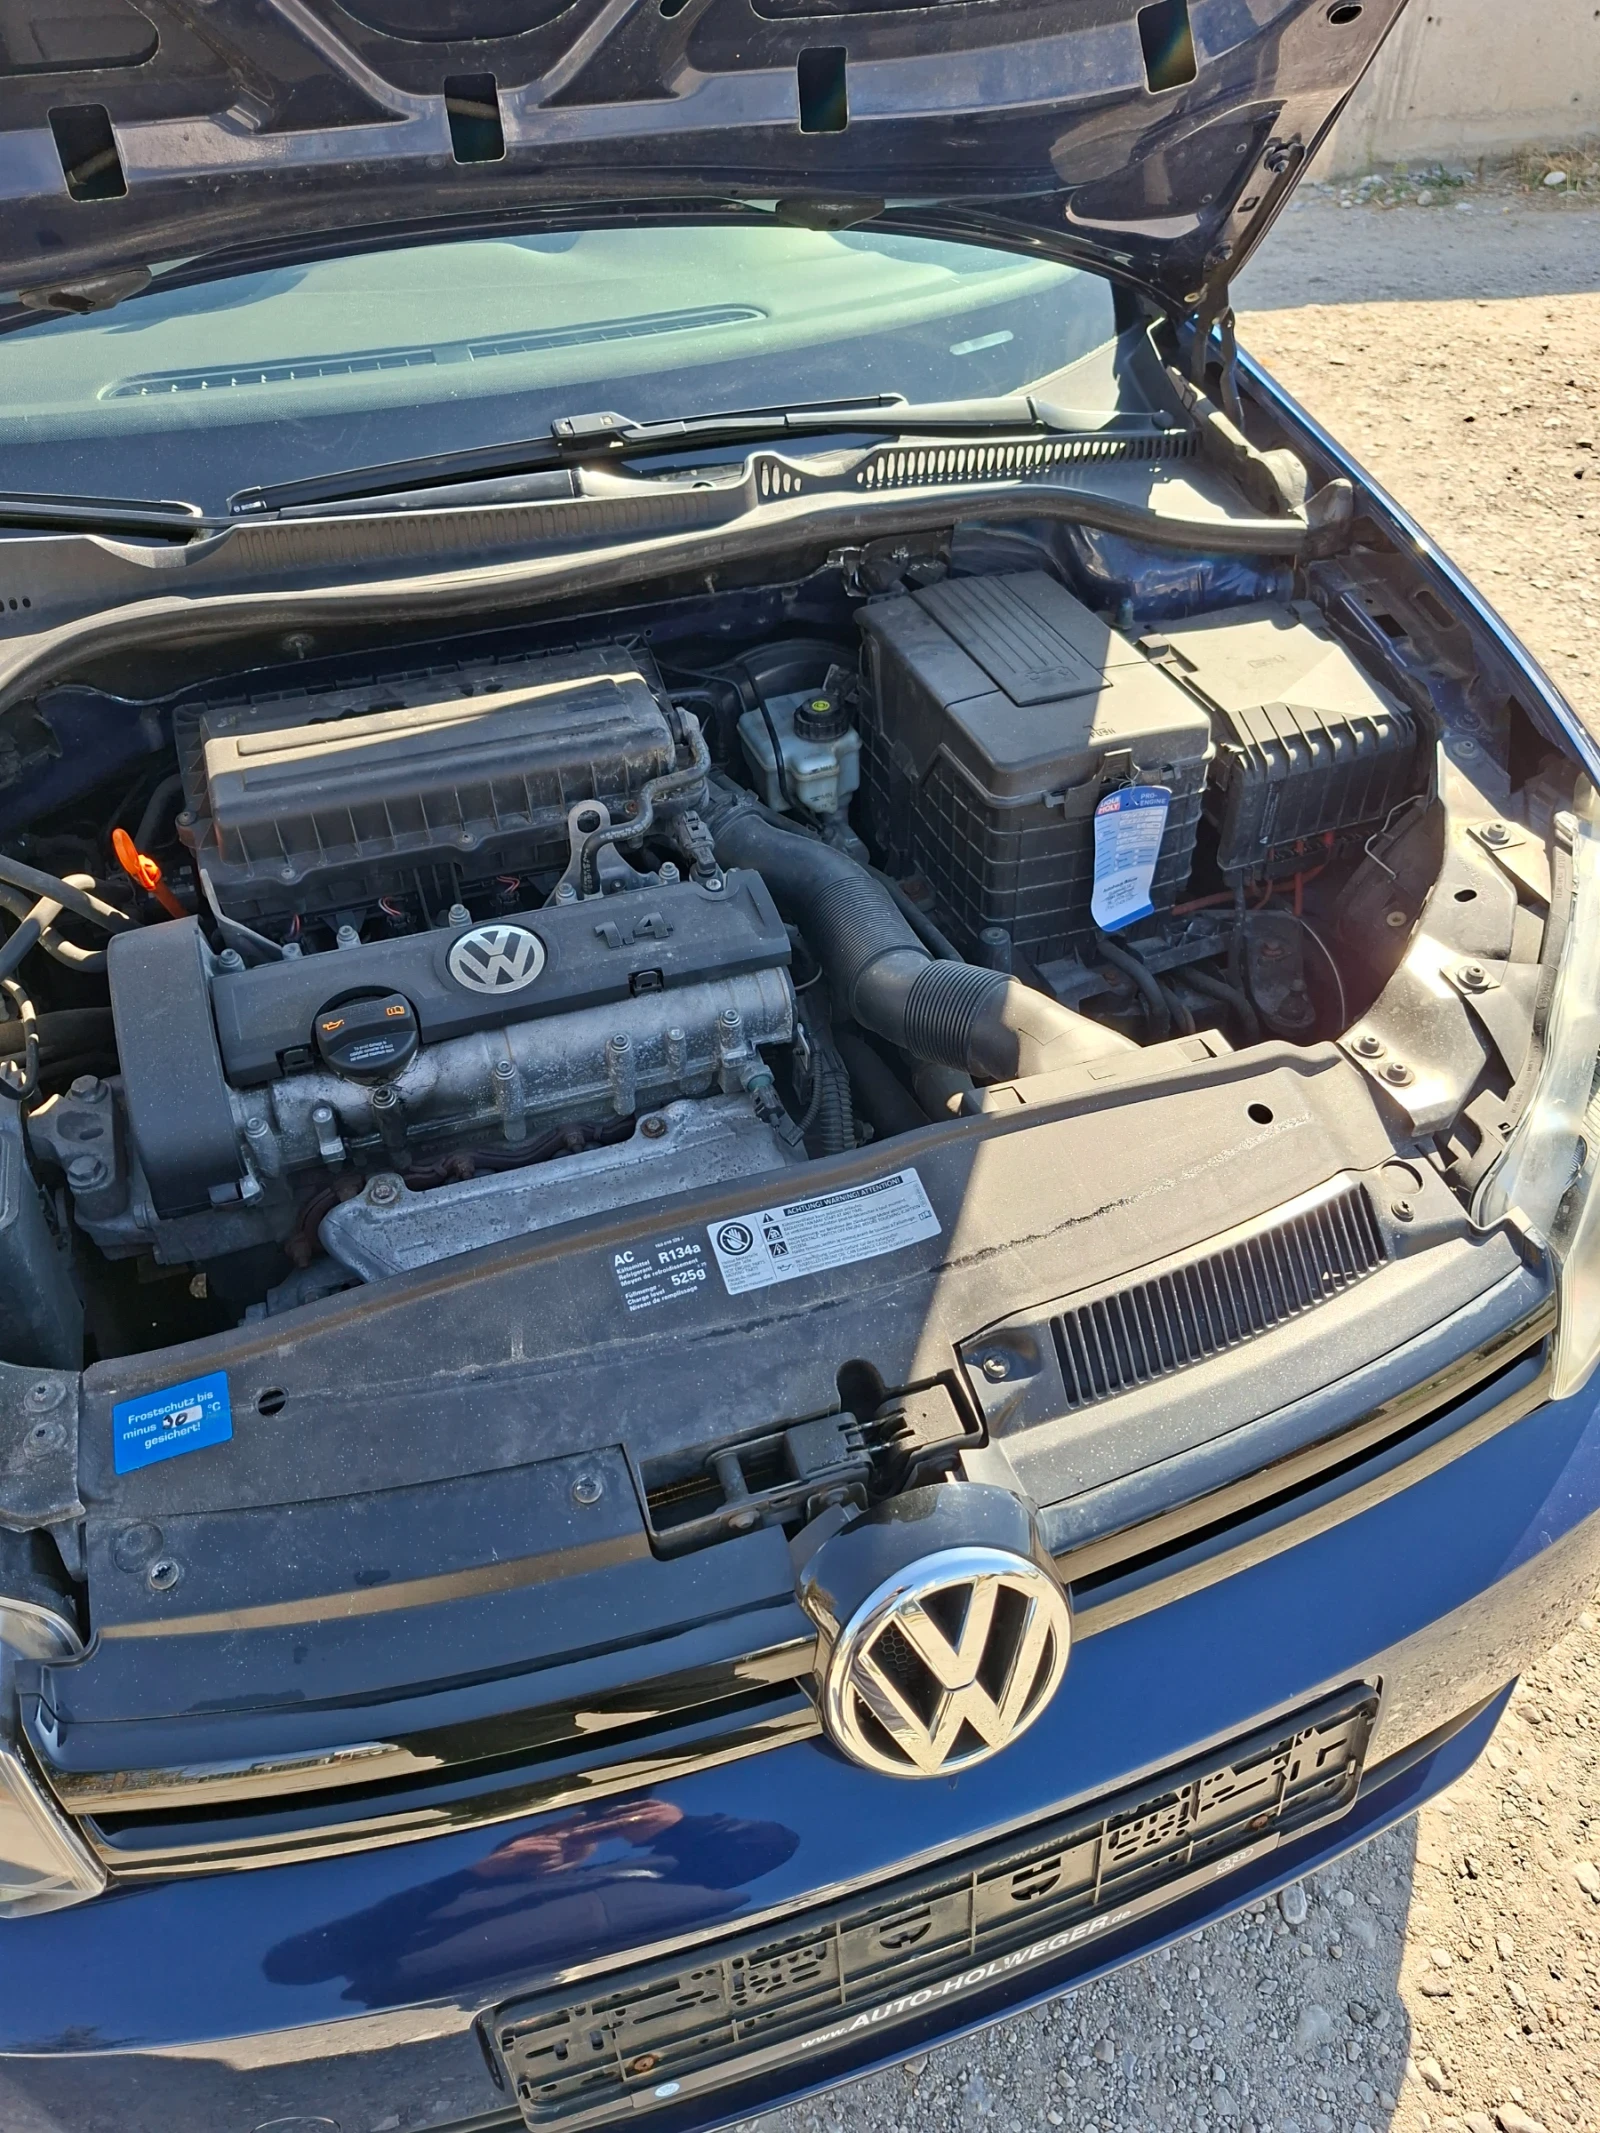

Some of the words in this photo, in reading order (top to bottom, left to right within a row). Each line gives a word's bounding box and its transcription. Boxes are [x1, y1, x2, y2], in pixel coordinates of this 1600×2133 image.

[1140, 792, 1158, 800] PRO-
[1140, 798, 1167, 807] ENGINE
[1097, 803, 1120, 815] MOLY
[593, 911, 674, 949] 1.4
[786, 1201, 824, 1216] ACHTUNG!
[824, 1190, 860, 1206] WARNING!
[861, 1177, 901, 1196] ATTENTION!
[614, 1250, 635, 1267] AC
[657, 1244, 702, 1264] R134a
[618, 1266, 653, 1281] Refrigerant
[620, 1275, 642, 1287] Moyen
[652, 1258, 699, 1277] refroidissement
[671, 1268, 707, 1286] 525g
[627, 1294, 650, 1305] Charge
[650, 1288, 666, 1298] level
[629, 1300, 652, 1312] Niveau
[127, 1397, 195, 1425] Frostschutz
[197, 1390, 214, 1402] bis
[123, 1422, 157, 1440] minus
[144, 1422, 201, 1449] gesichert!
[800, 1908, 1132, 2049] www.AUTO-HOLWEGER.de
